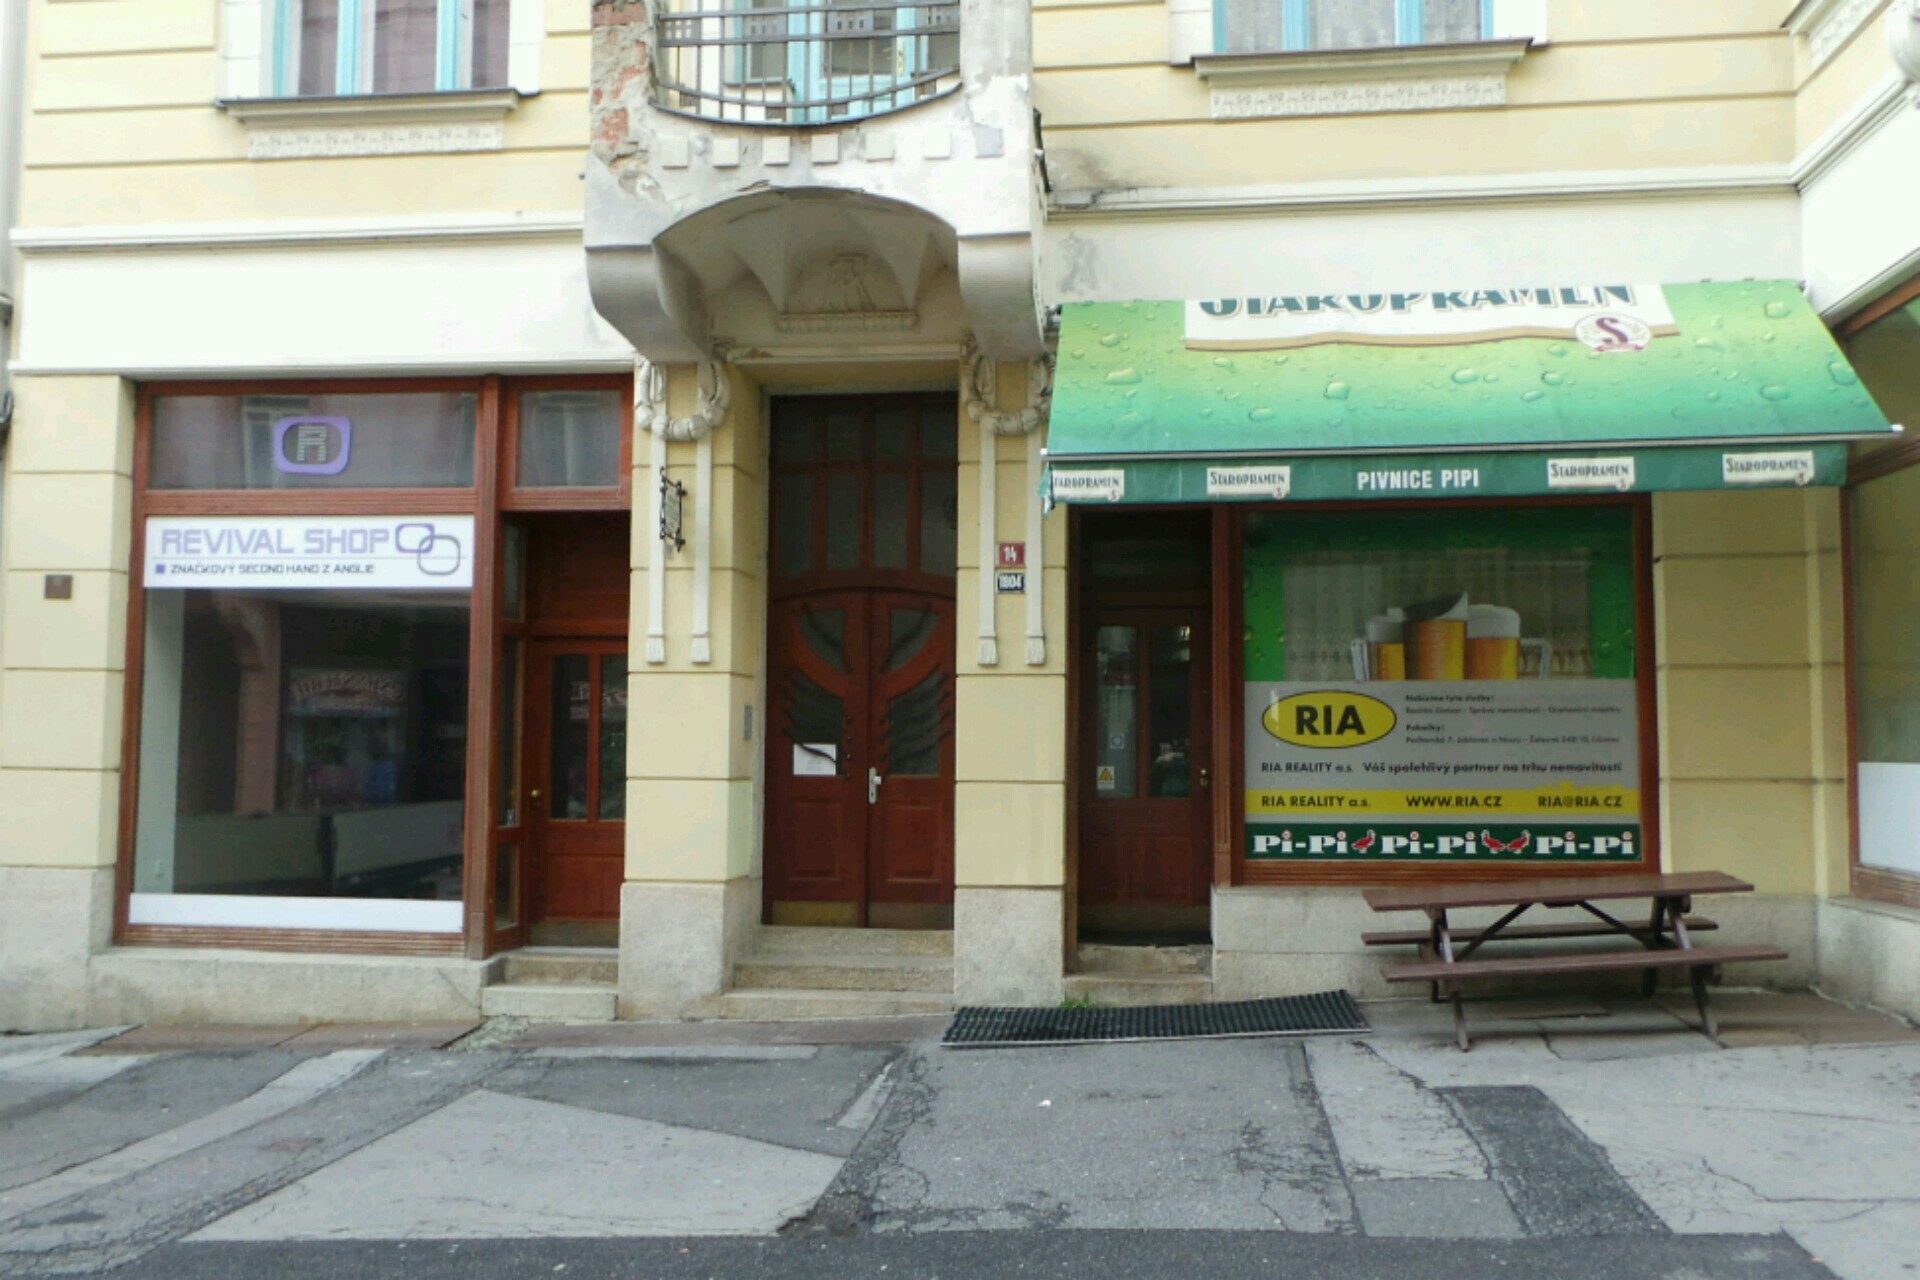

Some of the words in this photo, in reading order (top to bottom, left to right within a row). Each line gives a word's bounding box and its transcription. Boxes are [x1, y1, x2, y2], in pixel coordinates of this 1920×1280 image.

[1550, 463, 1629, 478] STAROPRAMEN
[1726, 457, 1809, 472] STAROPRAMEN
[1210, 471, 1286, 485] STAROPRAMEN
[1357, 470, 1433, 491] PIVNICE
[1441, 468, 1480, 488] PIPI
[161, 528, 295, 555] REVIVAL
[304, 528, 390, 554] SHOP
[239, 564, 284, 575] SECOND
[286, 564, 319, 574] HAND
[321, 564, 331, 574] Z
[333, 564, 375, 574] ANGLIE
[1295, 704, 1366, 735] RIA
[1261, 762, 1282, 773] RIA
[1285, 762, 1332, 773] REALITY
[1363, 761, 1386, 773] Váš
[1389, 761, 1450, 775] spolehlivý
[1453, 762, 1500, 775] partner
[1503, 764, 1519, 773] na
[1522, 762, 1547, 773] trhu
[1550, 761, 1623, 773] nemovitostí
[1261, 795, 1286, 807] RIA
[1290, 795, 1345, 807] REALITY
[1406, 796, 1503, 807] WWW.RIA.CZ
[1537, 796, 1623, 807] RIA@RIA.CZ
